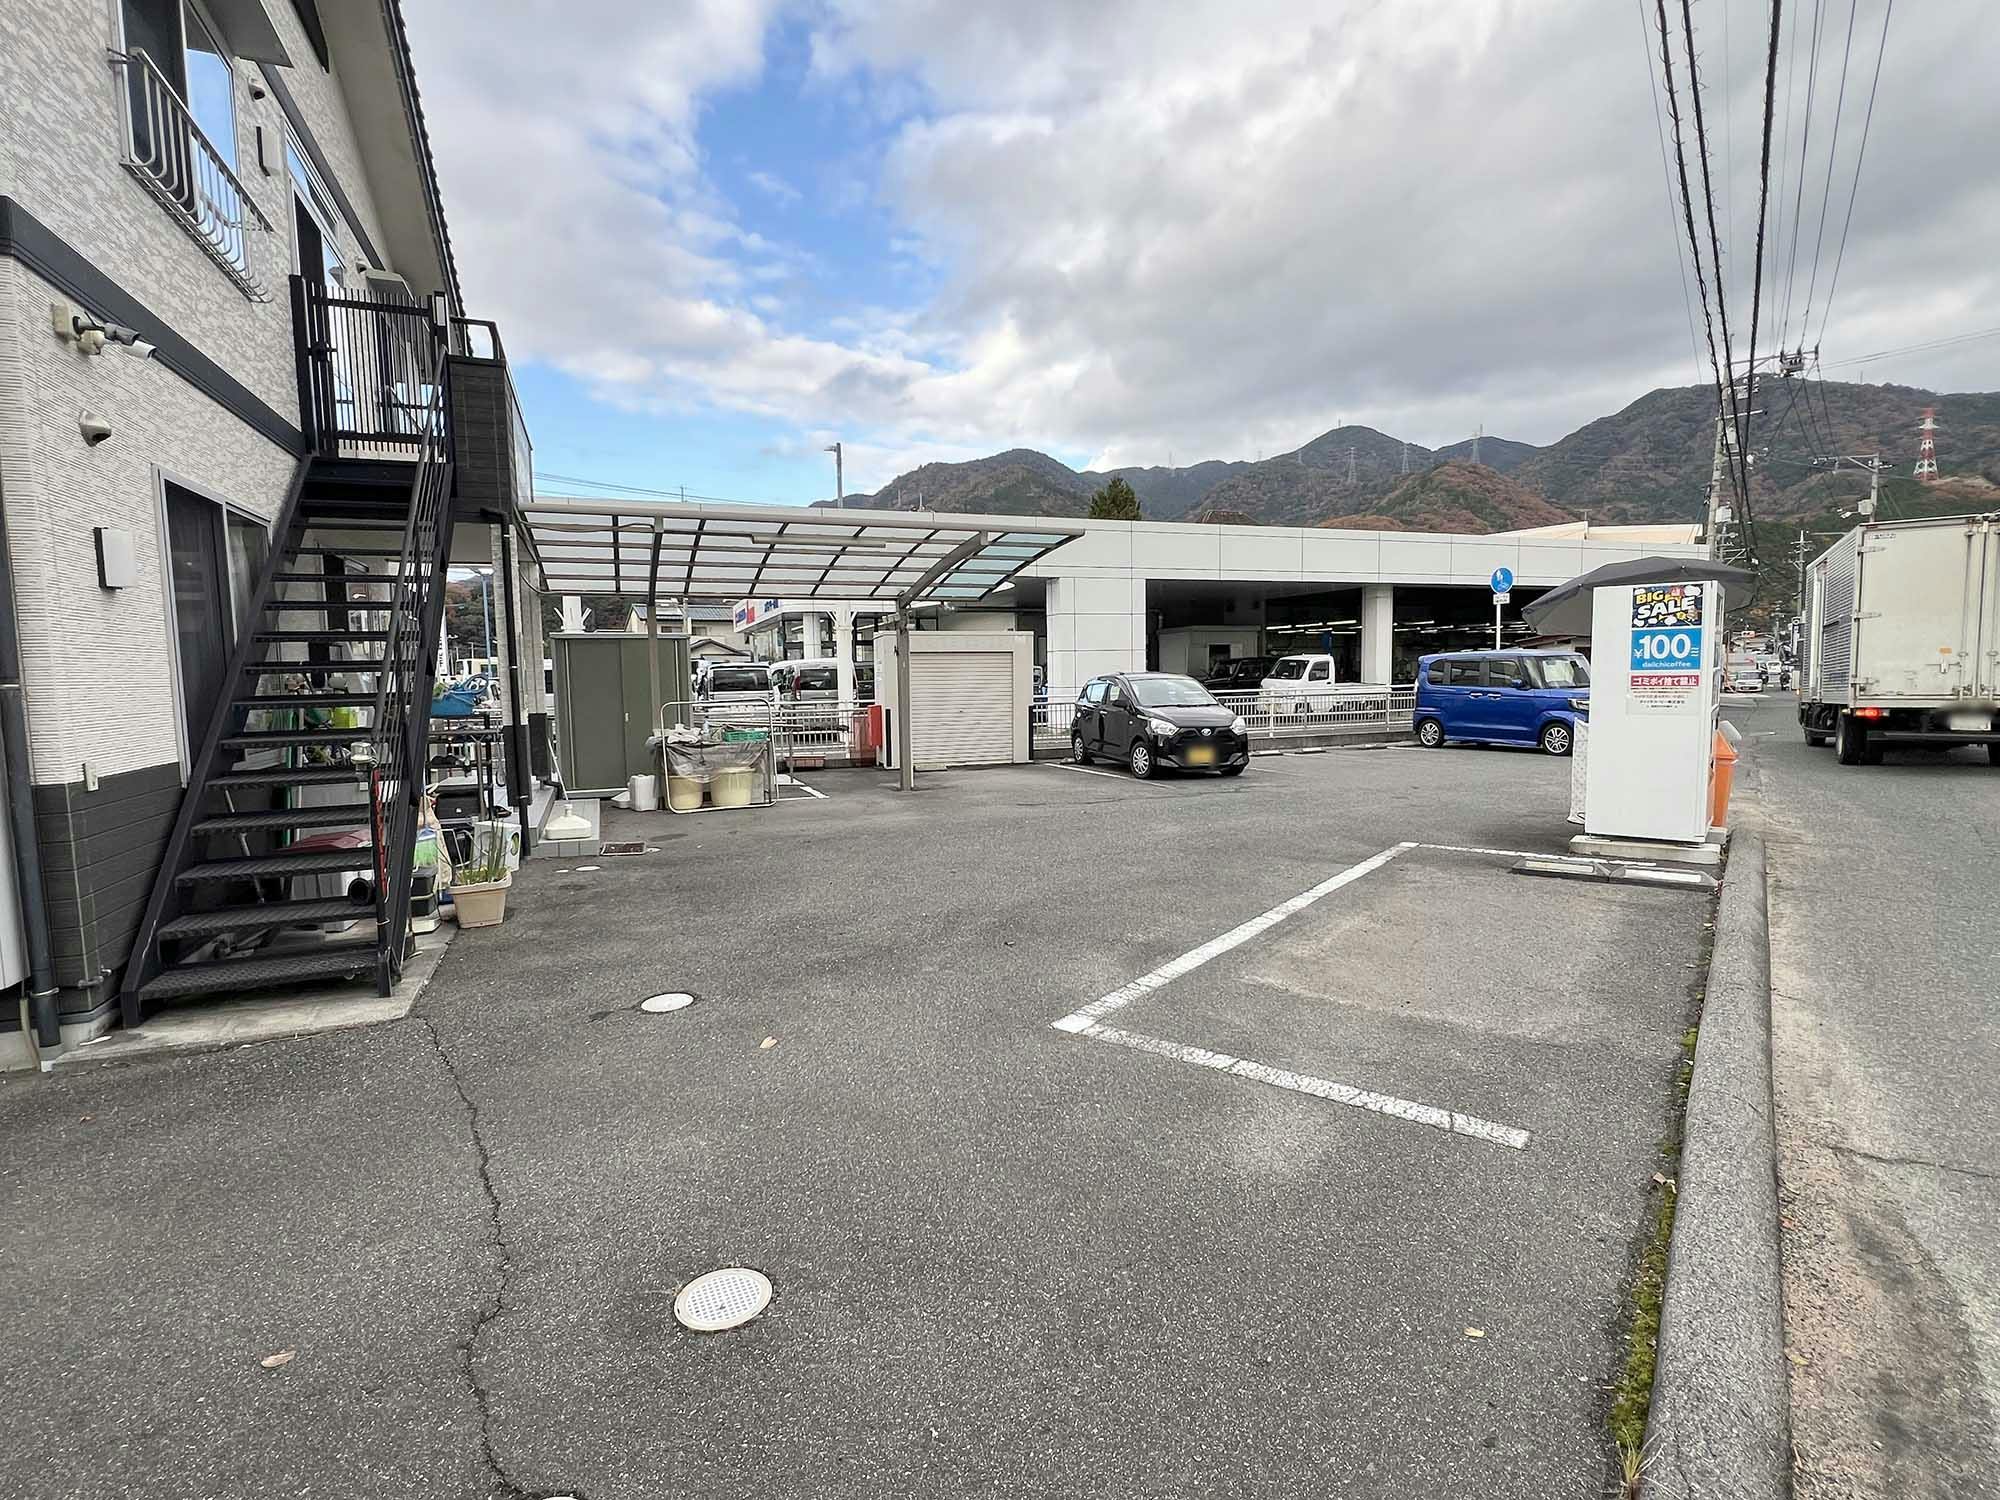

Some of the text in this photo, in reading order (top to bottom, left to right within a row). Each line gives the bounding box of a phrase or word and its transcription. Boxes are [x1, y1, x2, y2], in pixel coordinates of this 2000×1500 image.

[1636, 590, 1664, 604] BIG
[1637, 596, 1695, 619] SALE
[1642, 660, 1692, 668] daiichicoffee
[1632, 677, 1696, 686] ゴミポイ捨て禁止
